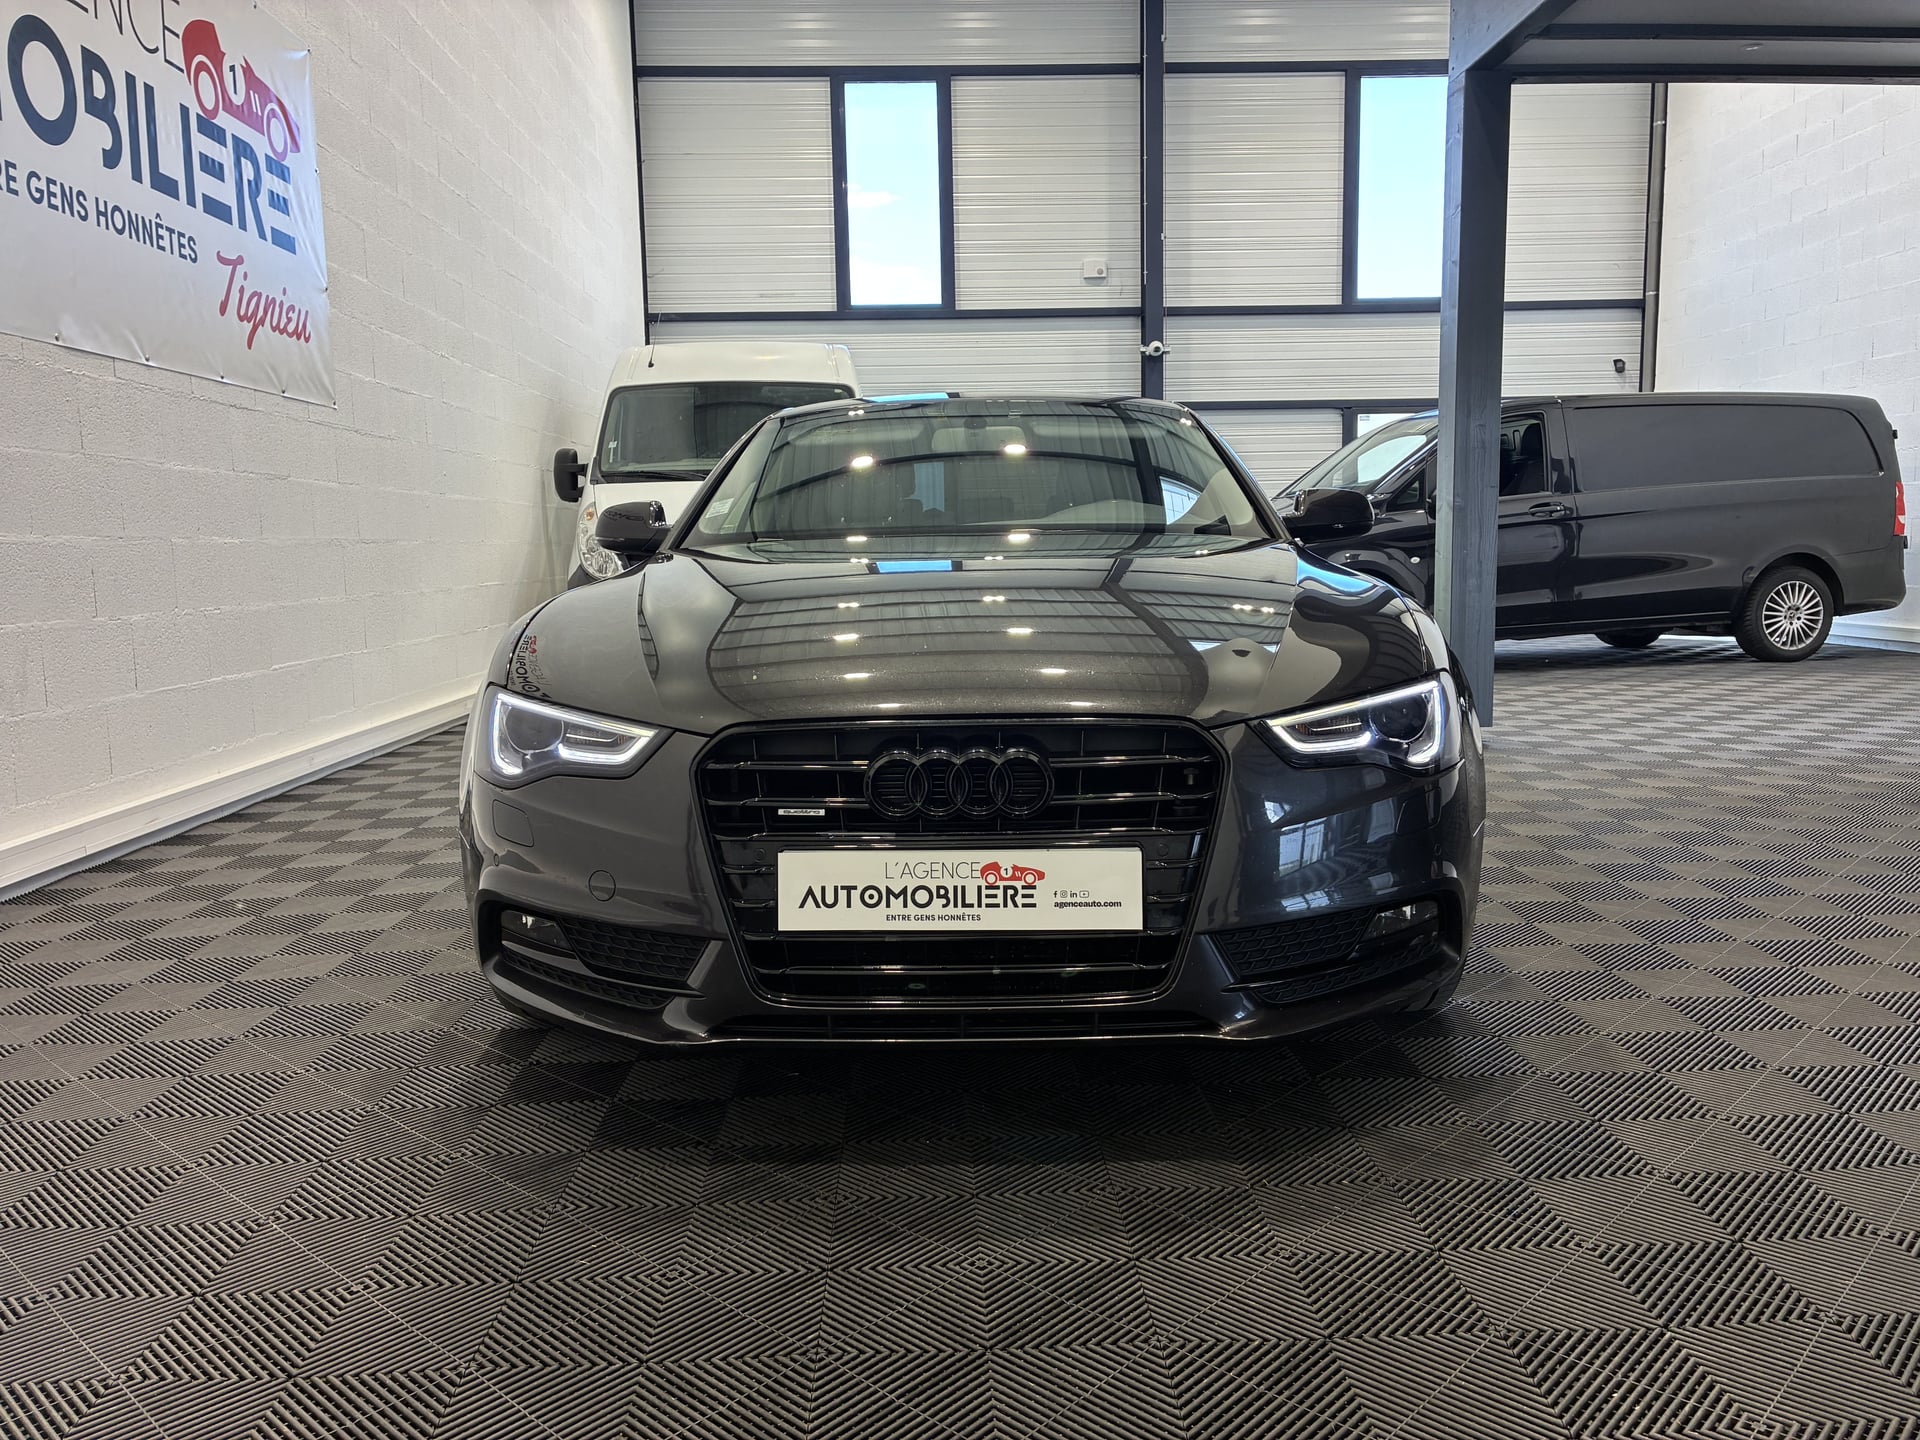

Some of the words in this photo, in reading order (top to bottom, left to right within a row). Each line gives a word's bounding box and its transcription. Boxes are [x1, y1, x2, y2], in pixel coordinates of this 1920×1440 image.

[0, 14, 297, 256] OBILIERE
[0, 159, 19, 197] E
[26, 170, 89, 222] GENS
[95, 197, 199, 264] HONNÊTES
[216, 250, 311, 350] Tignieu
[885, 861, 981, 880] L'AGENCE
[798, 884, 1037, 909] AUTOMOBILIERE
[1053, 900, 1122, 909] agenceauto.com
[886, 914, 912, 922] ENTRE
[913, 914, 936, 922] GENS
[937, 912, 982, 922] HONNÊTES
